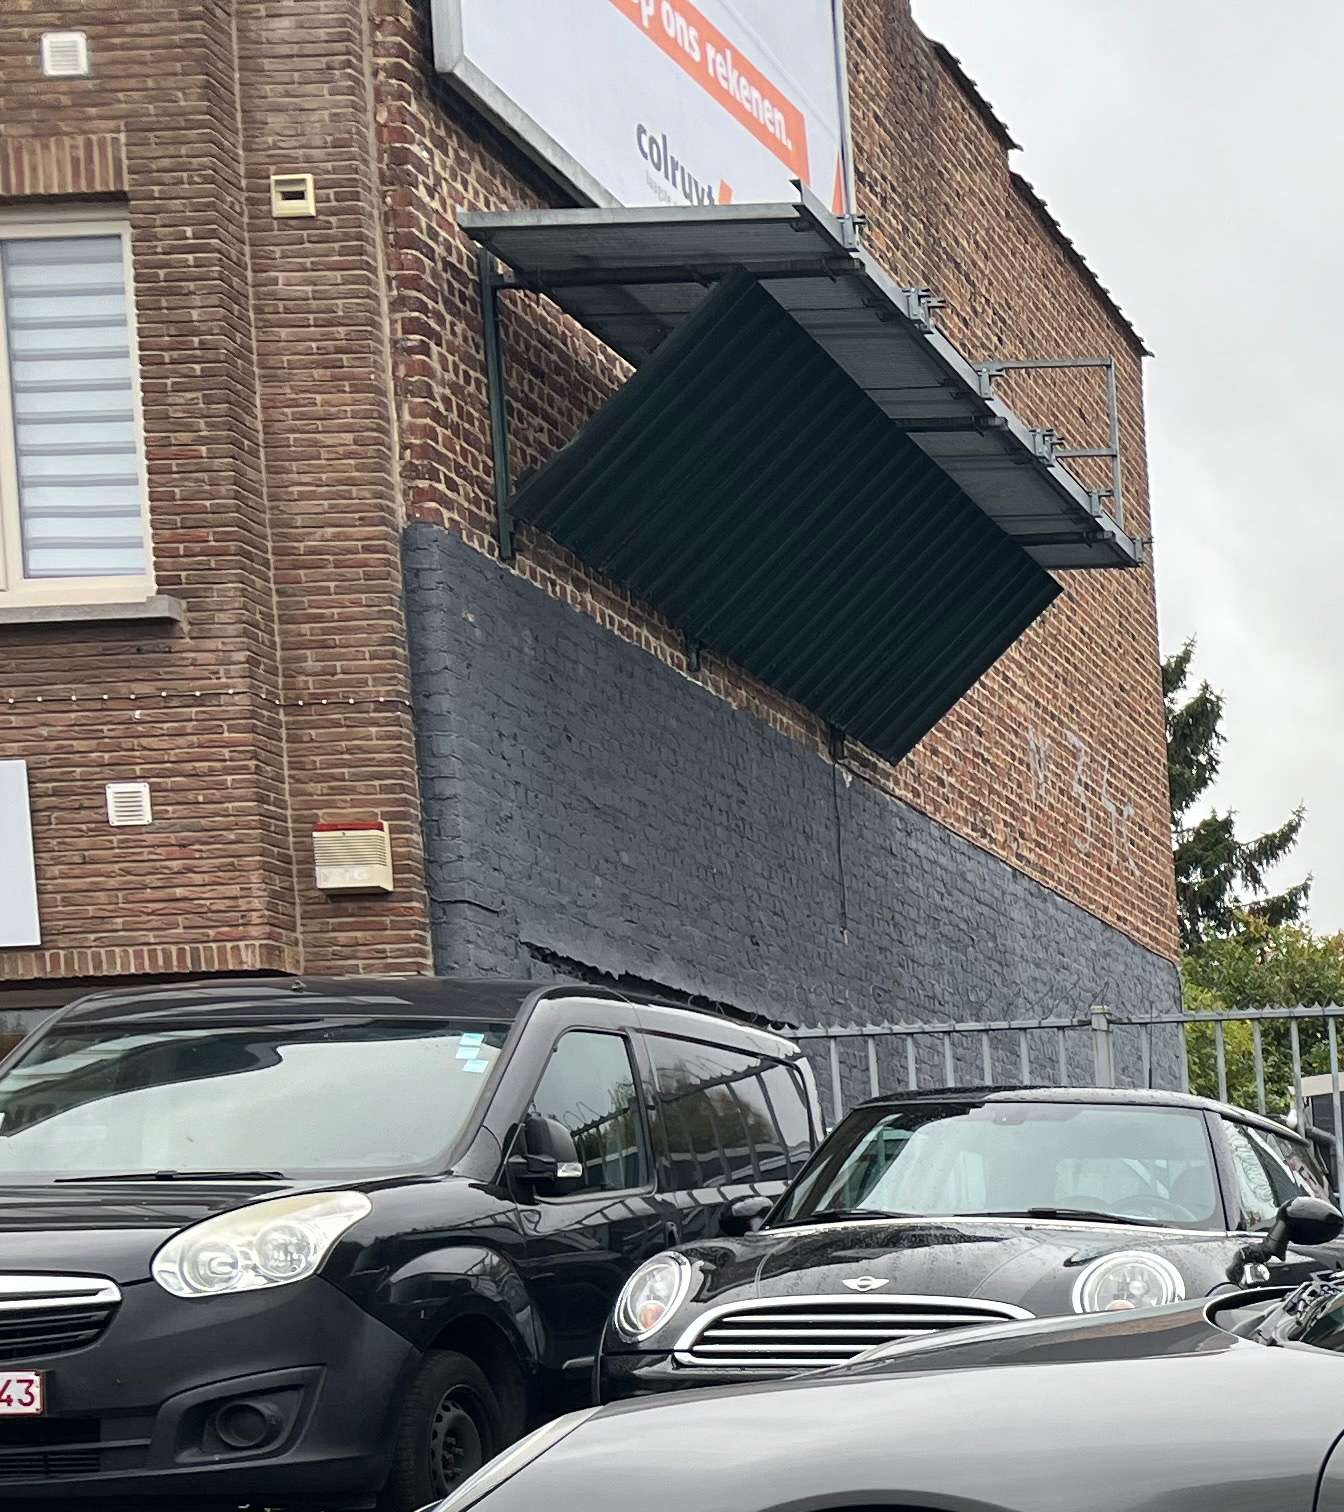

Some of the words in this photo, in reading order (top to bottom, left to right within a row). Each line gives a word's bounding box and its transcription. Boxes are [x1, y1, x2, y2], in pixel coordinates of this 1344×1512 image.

[631, 0, 655, 28] p
[660, 1, 701, 63] ons
[705, 42, 792, 151] rekenen.
[0, 1379, 35, 1407] 43
